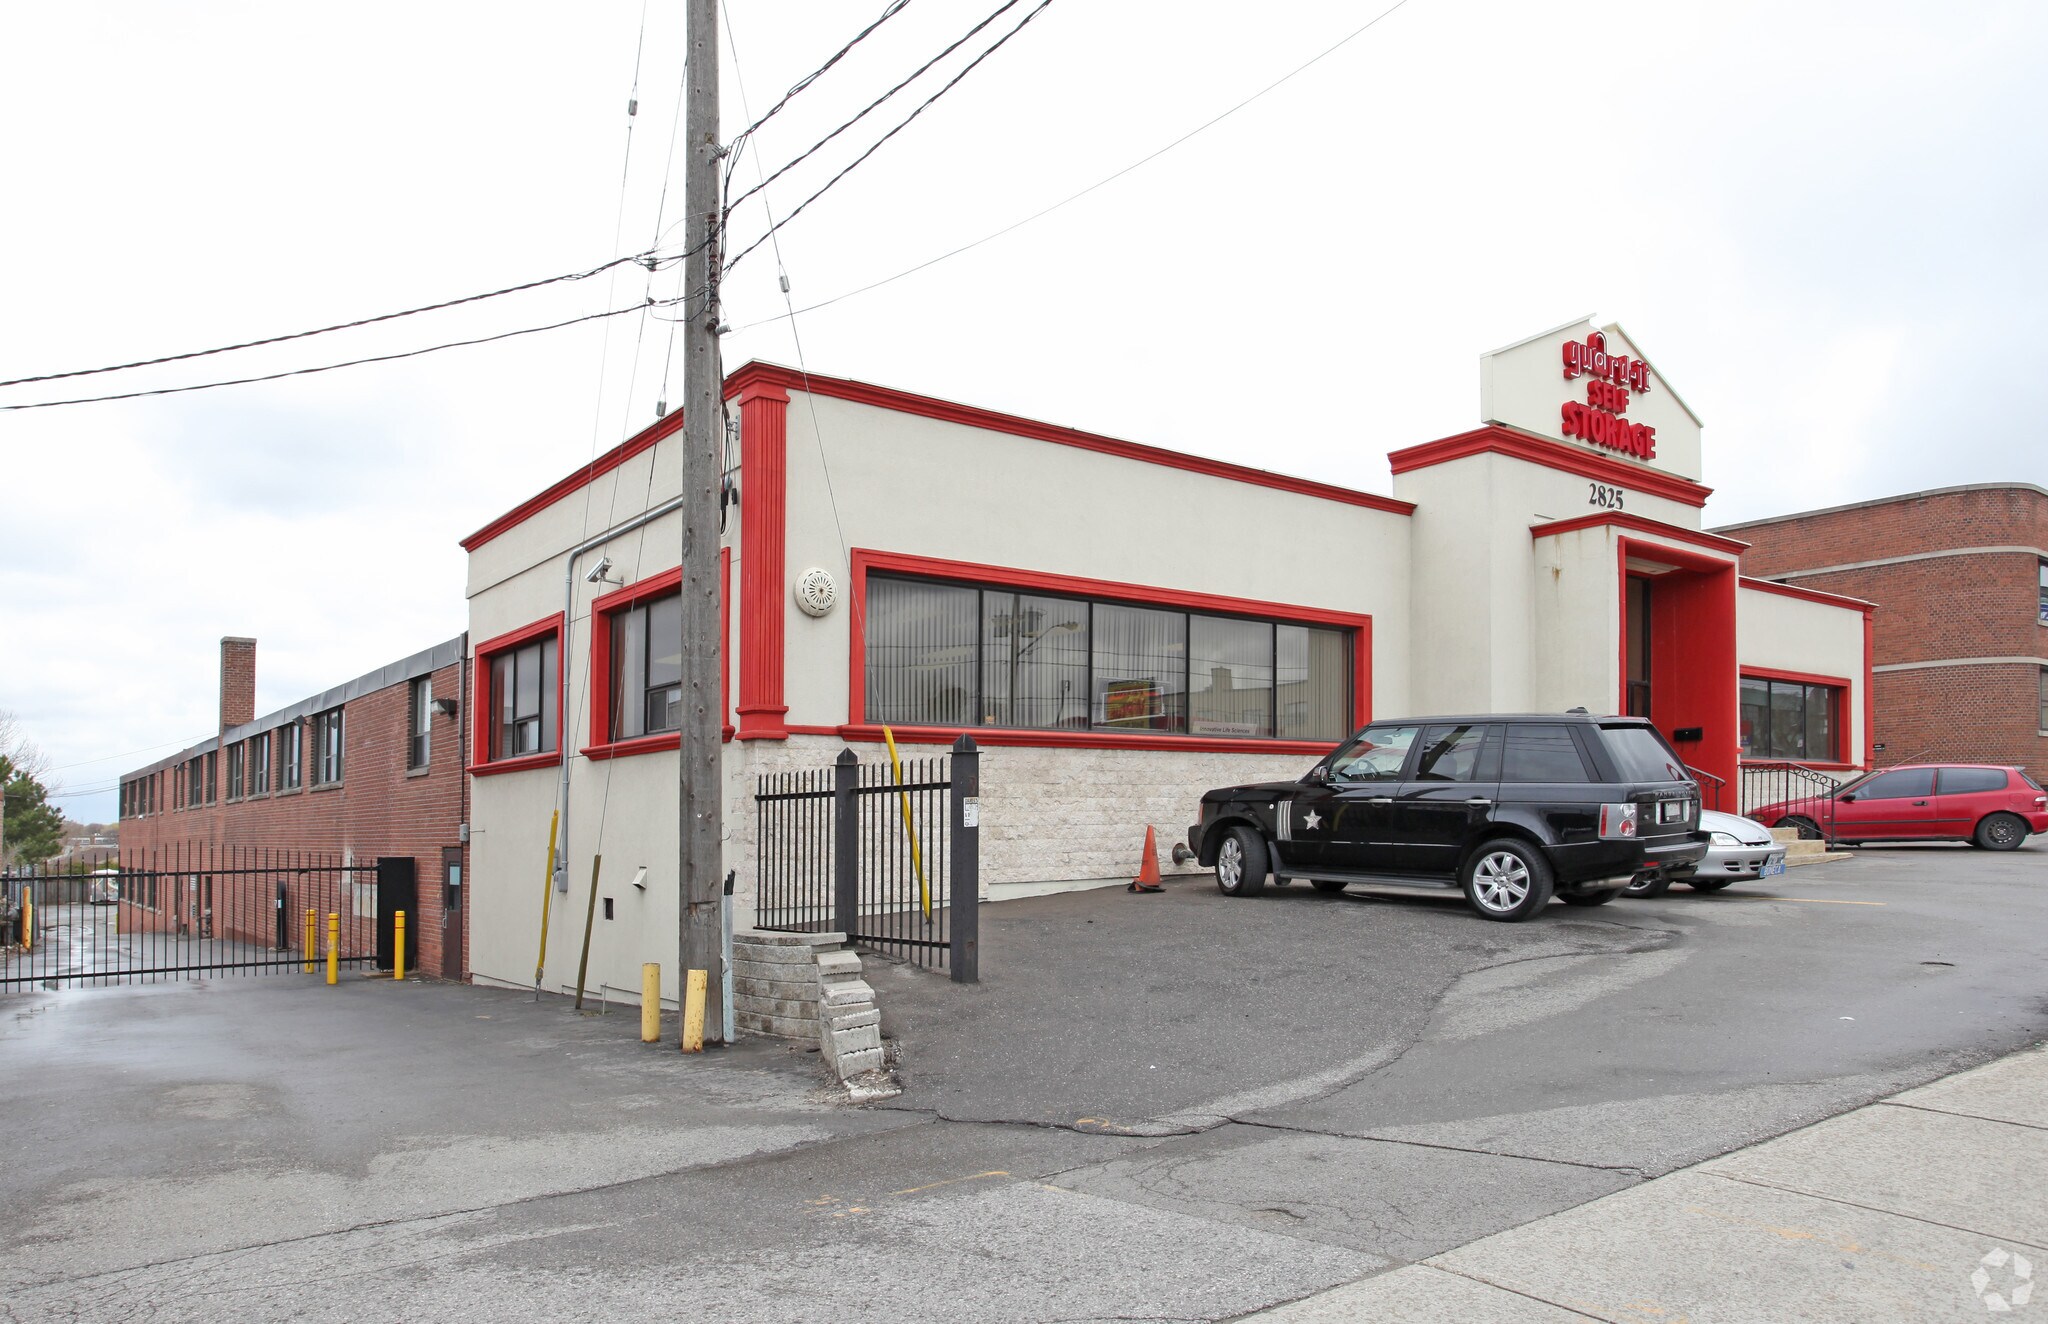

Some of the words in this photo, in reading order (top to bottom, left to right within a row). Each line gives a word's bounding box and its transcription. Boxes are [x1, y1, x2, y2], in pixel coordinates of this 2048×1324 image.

[1587, 379, 1629, 414] SELF
[1561, 400, 1656, 459] STORAGE
[1588, 482, 1624, 510] 2825
